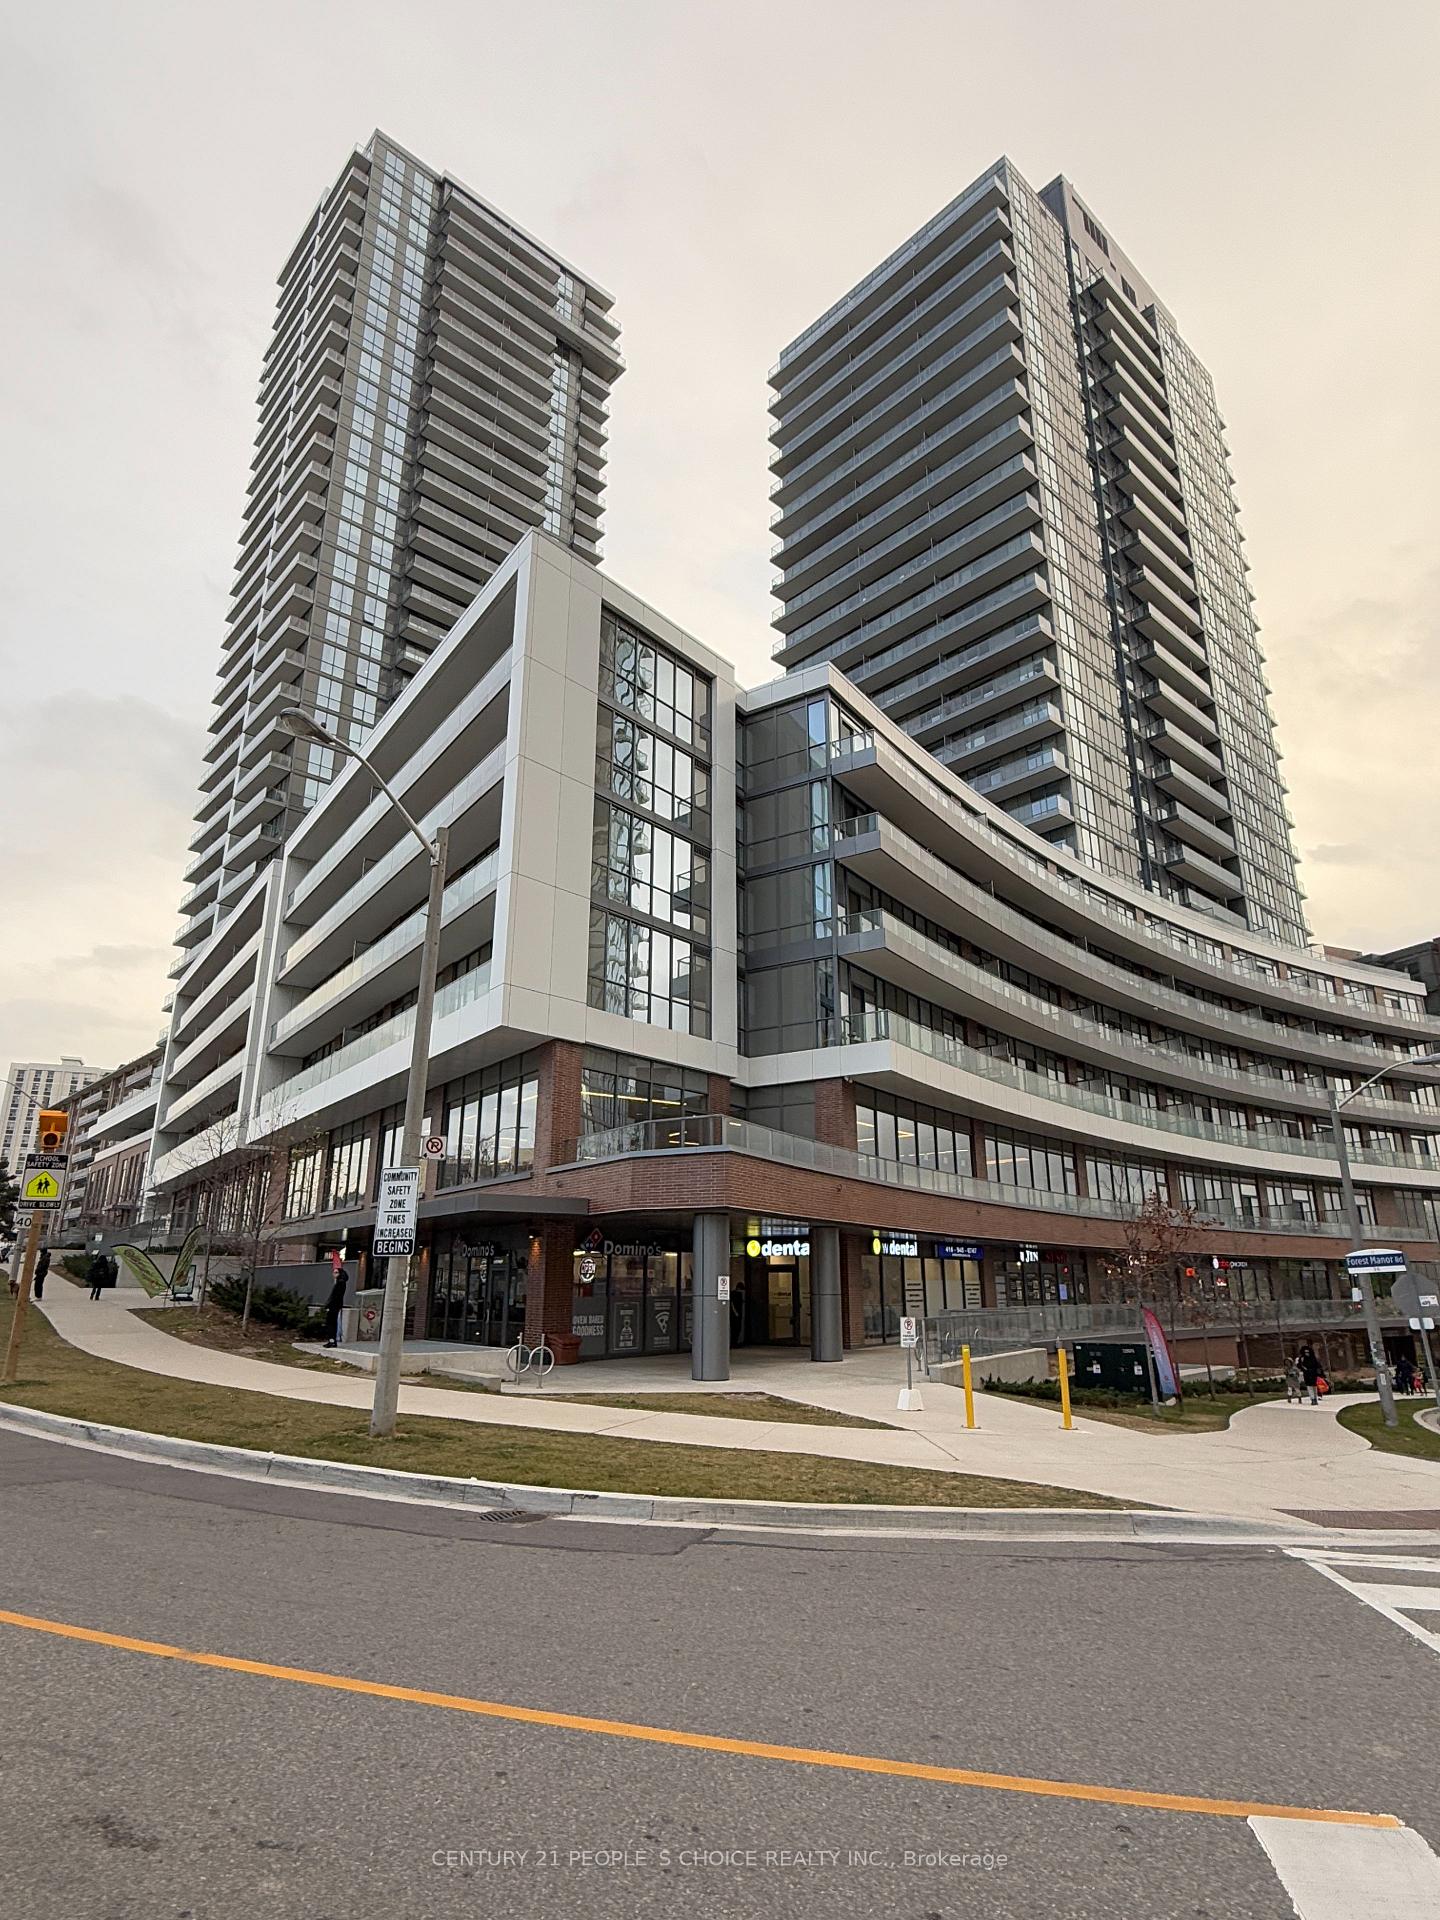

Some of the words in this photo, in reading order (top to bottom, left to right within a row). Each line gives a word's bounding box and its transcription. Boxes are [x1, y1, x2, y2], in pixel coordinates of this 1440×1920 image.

[383, 1171, 418, 1182] COMMUNITY
[387, 1185, 411, 1195] SAFETY
[389, 1199, 406, 1209] ZONE
[16, 1217, 32, 1227] 40
[386, 1214, 406, 1225] FINES
[377, 1227, 414, 1239] INCREASED
[376, 1240, 410, 1254] BEGINS
[462, 1241, 495, 1257] Domino's
[603, 1240, 662, 1257] Domino's
[761, 1239, 810, 1256] denta
[889, 1240, 918, 1256] dental
[1346, 1257, 1369, 1266] Forest
[1369, 1256, 1393, 1265] Manor
[572, 1325, 605, 1337] GOODNESS
